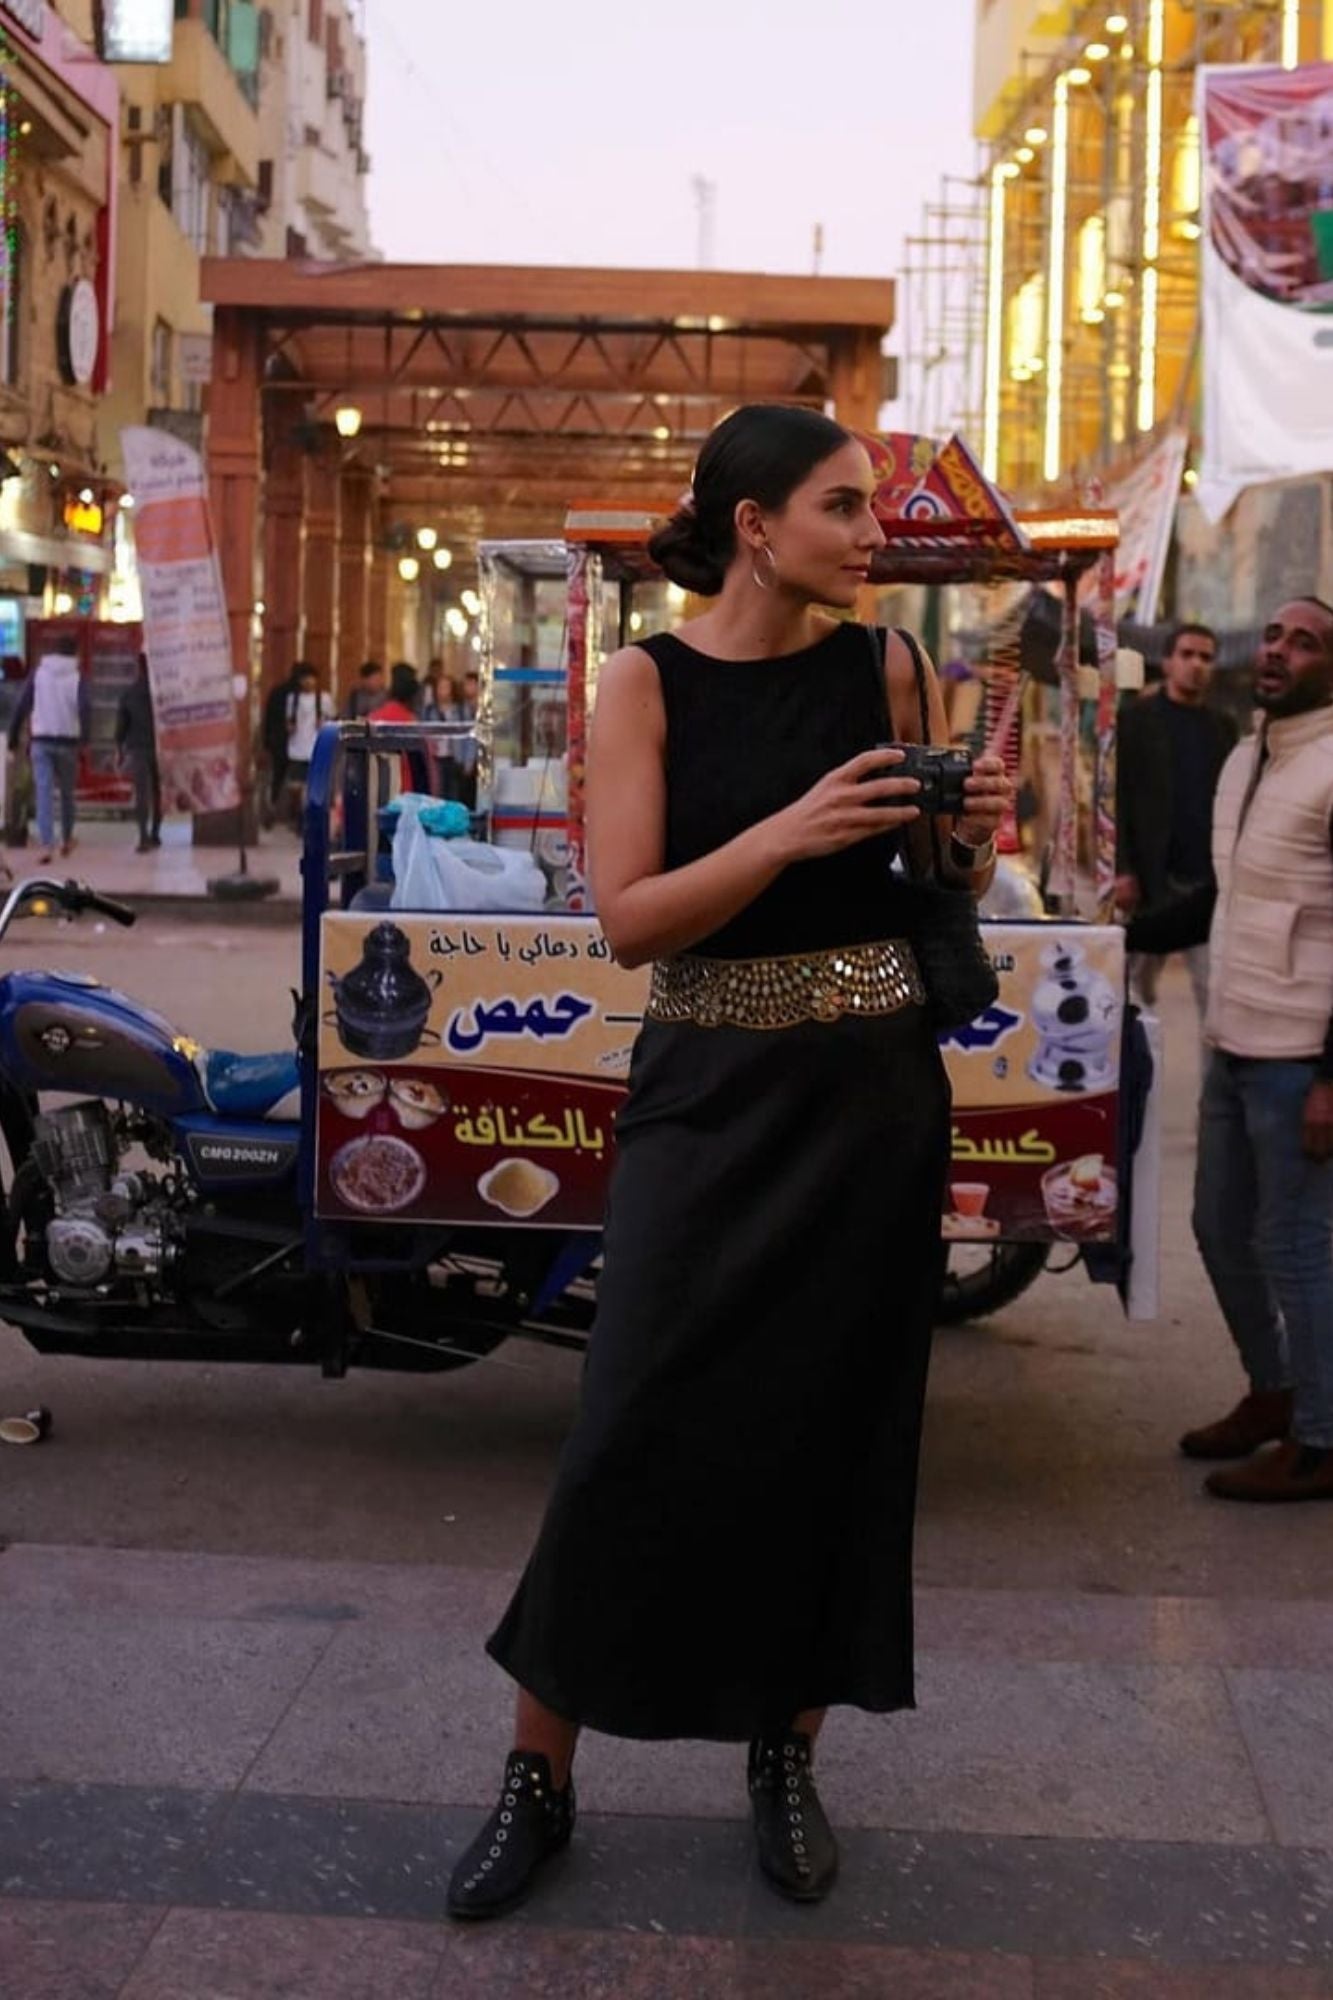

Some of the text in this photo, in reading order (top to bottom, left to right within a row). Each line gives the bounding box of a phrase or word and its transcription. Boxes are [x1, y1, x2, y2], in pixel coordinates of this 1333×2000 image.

[429, 929, 487, 960] حاجة
[448, 994, 593, 1051] حمص
[452, 1105, 1056, 1163] كسك بالكنافة
